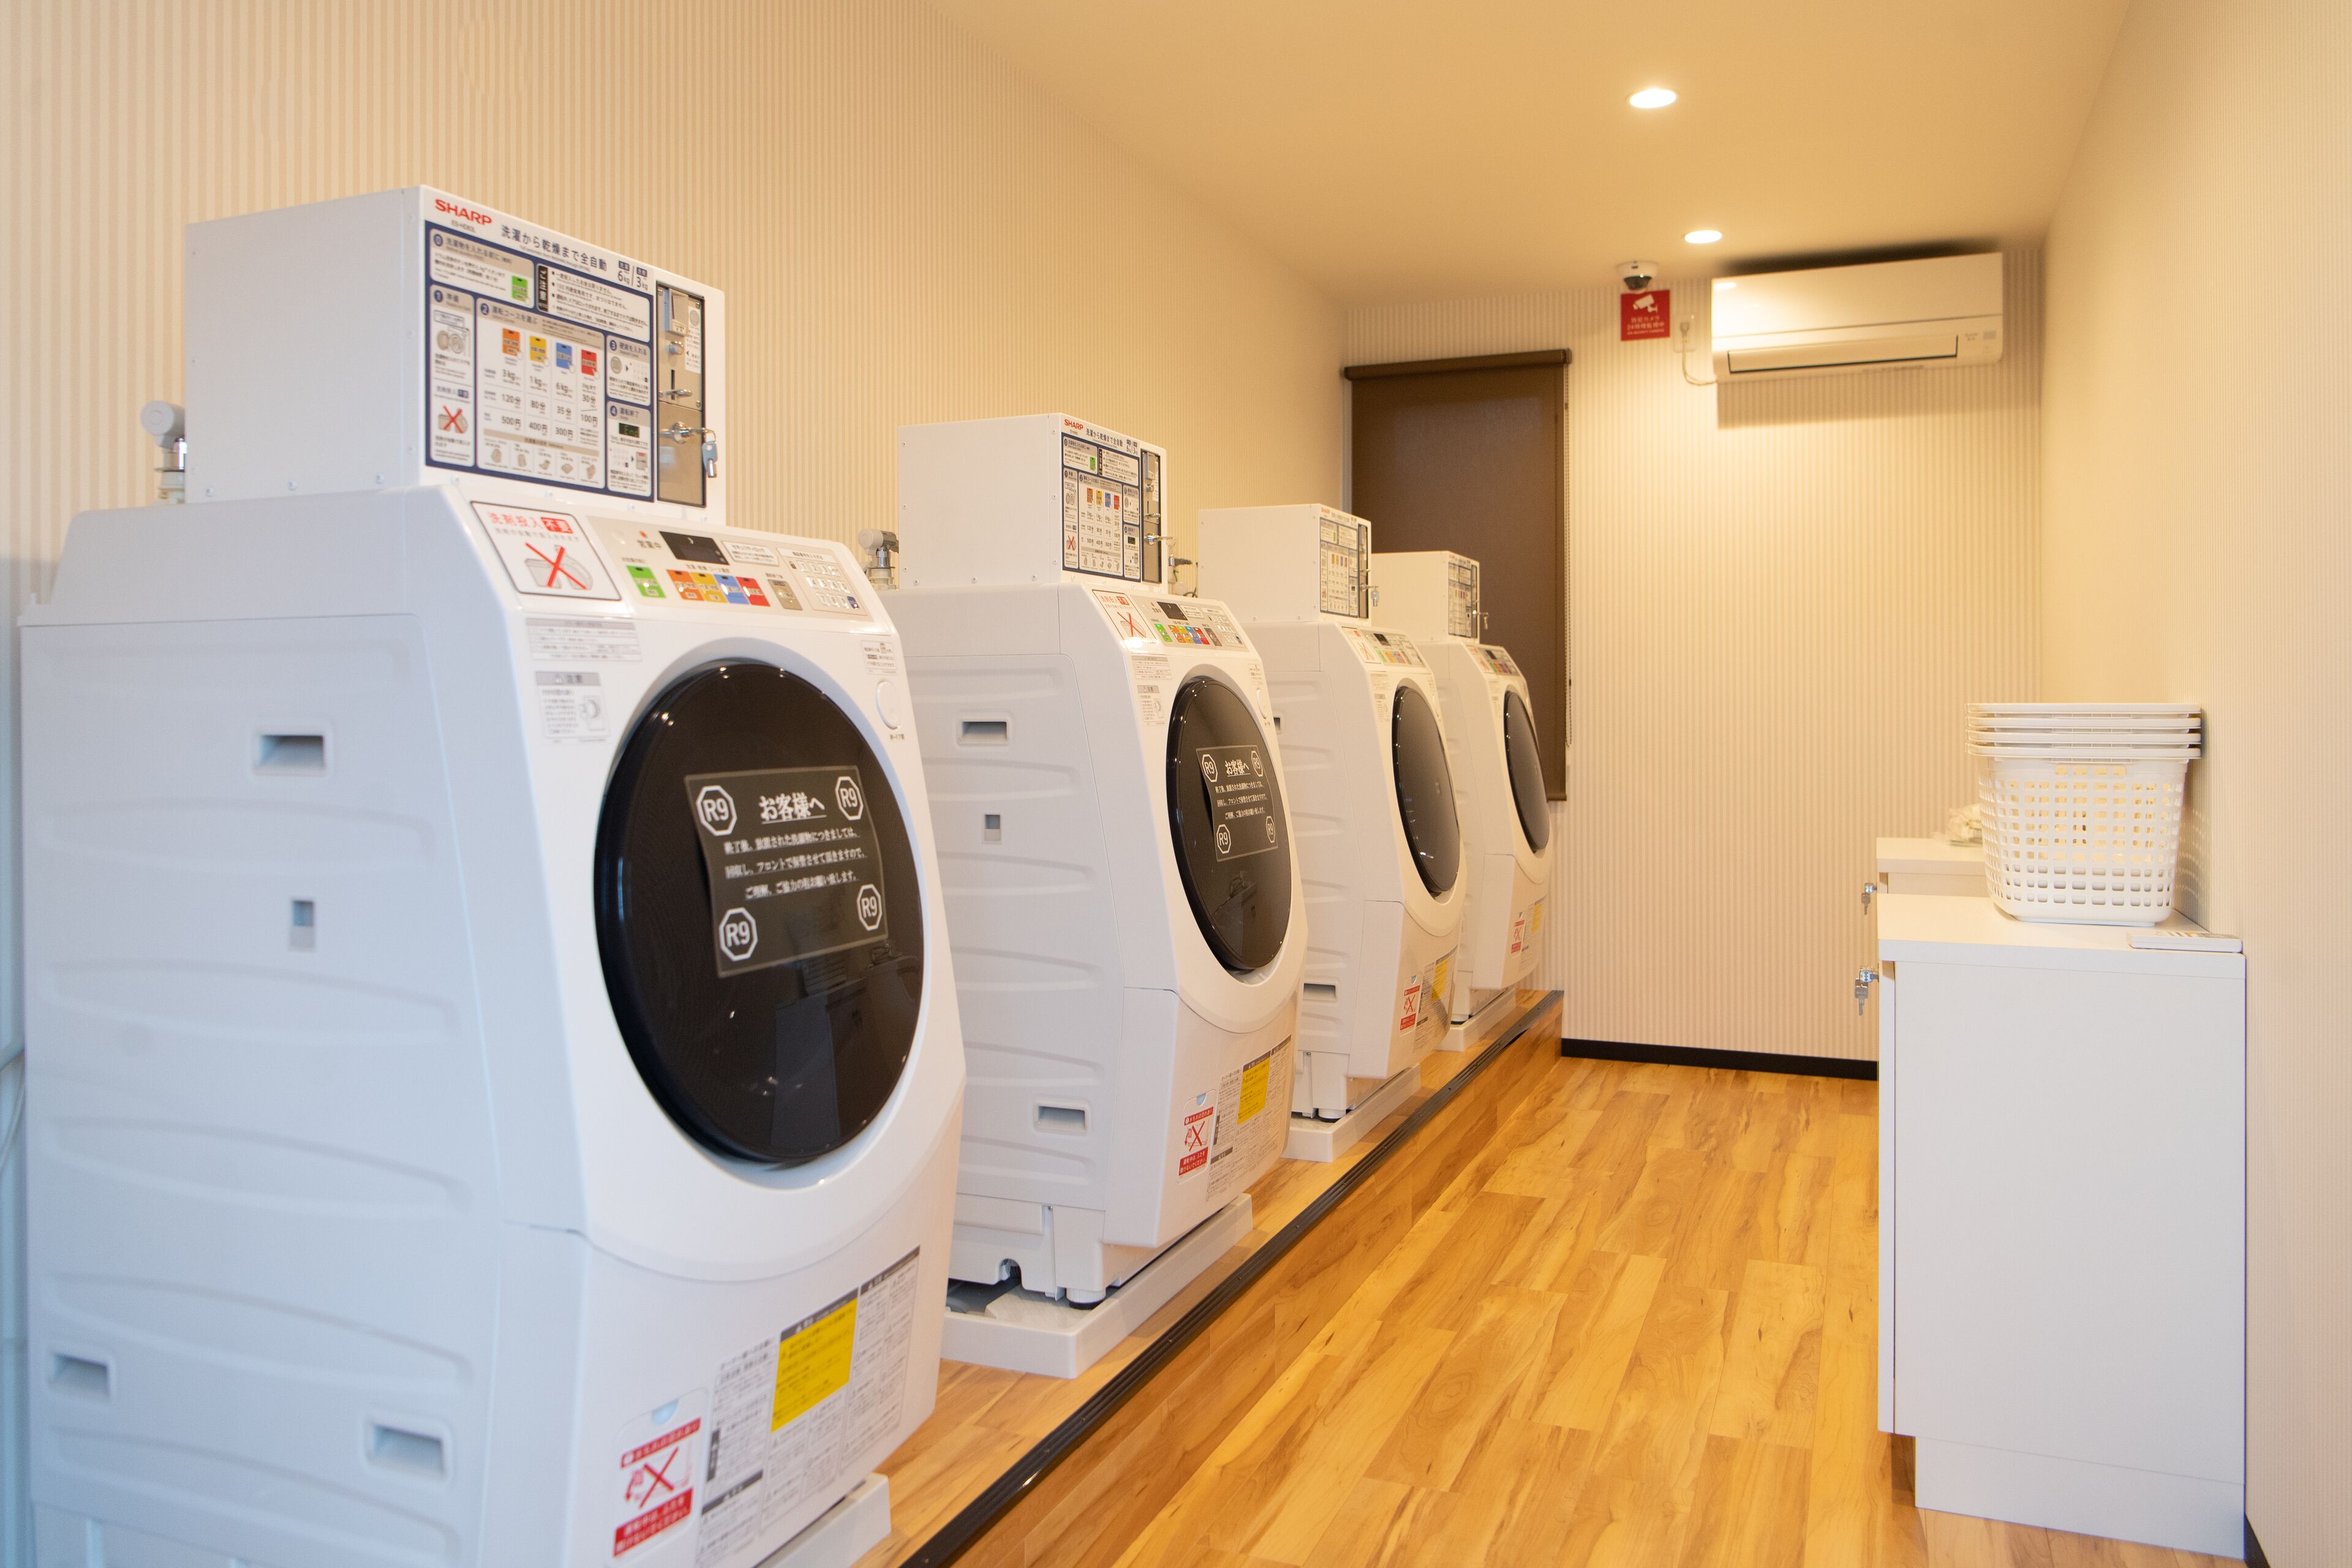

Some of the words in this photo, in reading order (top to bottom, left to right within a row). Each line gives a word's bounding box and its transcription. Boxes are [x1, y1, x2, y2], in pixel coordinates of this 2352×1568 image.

[435, 198, 492, 225] SHARP
[501, 225, 608, 272] 洗濯から乾燥まで全自動
[1065, 419, 1084, 431] SHARP
[1205, 762, 1215, 776] R9
[1225, 759, 1250, 775] お客様へ
[1253, 756, 1262, 770] R9
[703, 797, 730, 823] R9
[758, 791, 826, 821] お客様へ
[840, 787, 858, 809] R9
[1219, 832, 1229, 846] R9
[1267, 823, 1275, 835] R9
[725, 920, 750, 948] R9
[860, 897, 878, 919] R9
